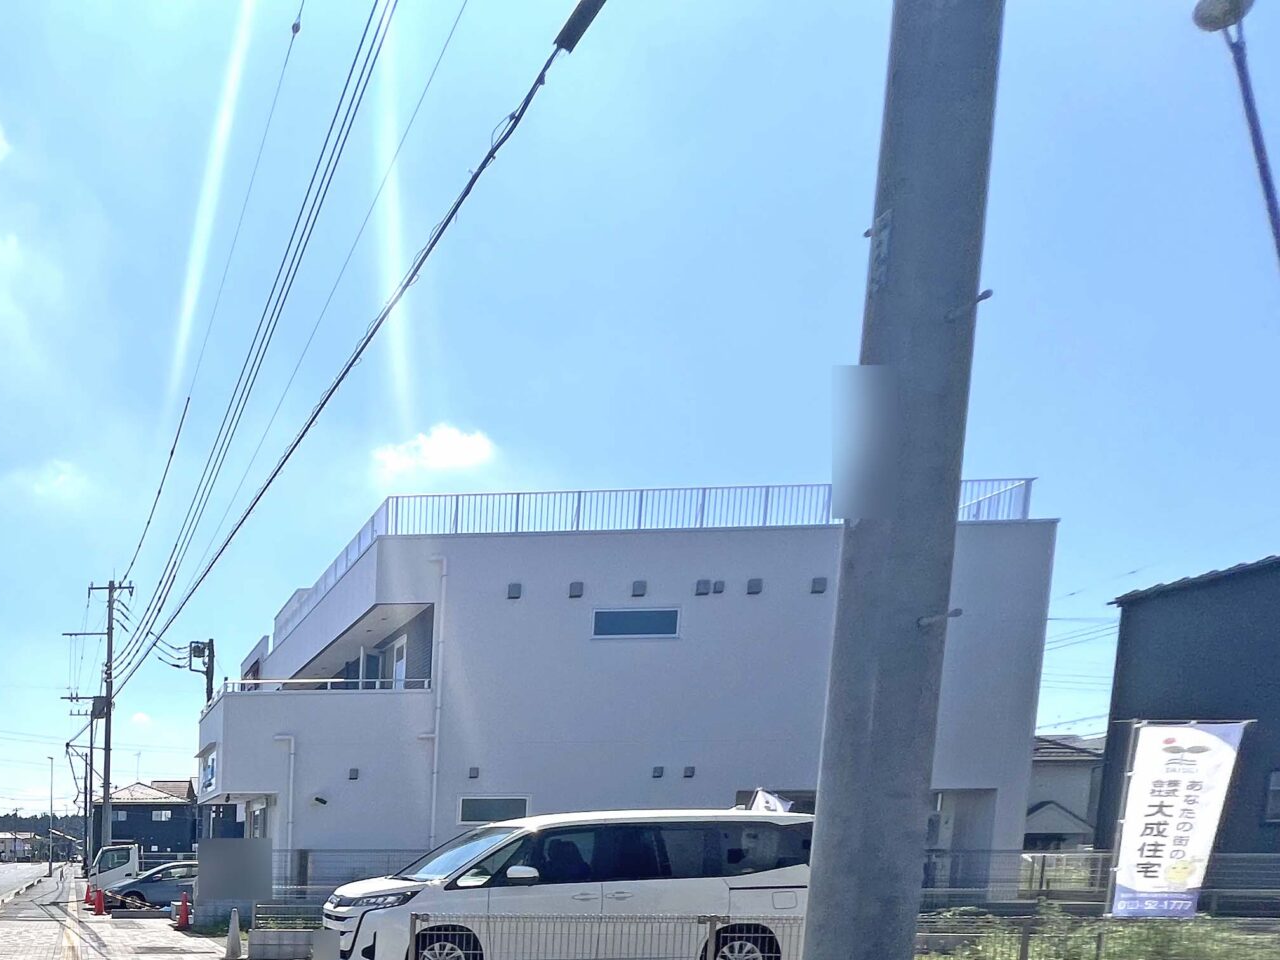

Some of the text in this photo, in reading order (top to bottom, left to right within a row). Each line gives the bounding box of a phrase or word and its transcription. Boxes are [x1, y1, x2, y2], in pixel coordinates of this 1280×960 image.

[1136, 800, 1174, 878] 大成住宅
[1169, 780, 1204, 860] あなたの街の
